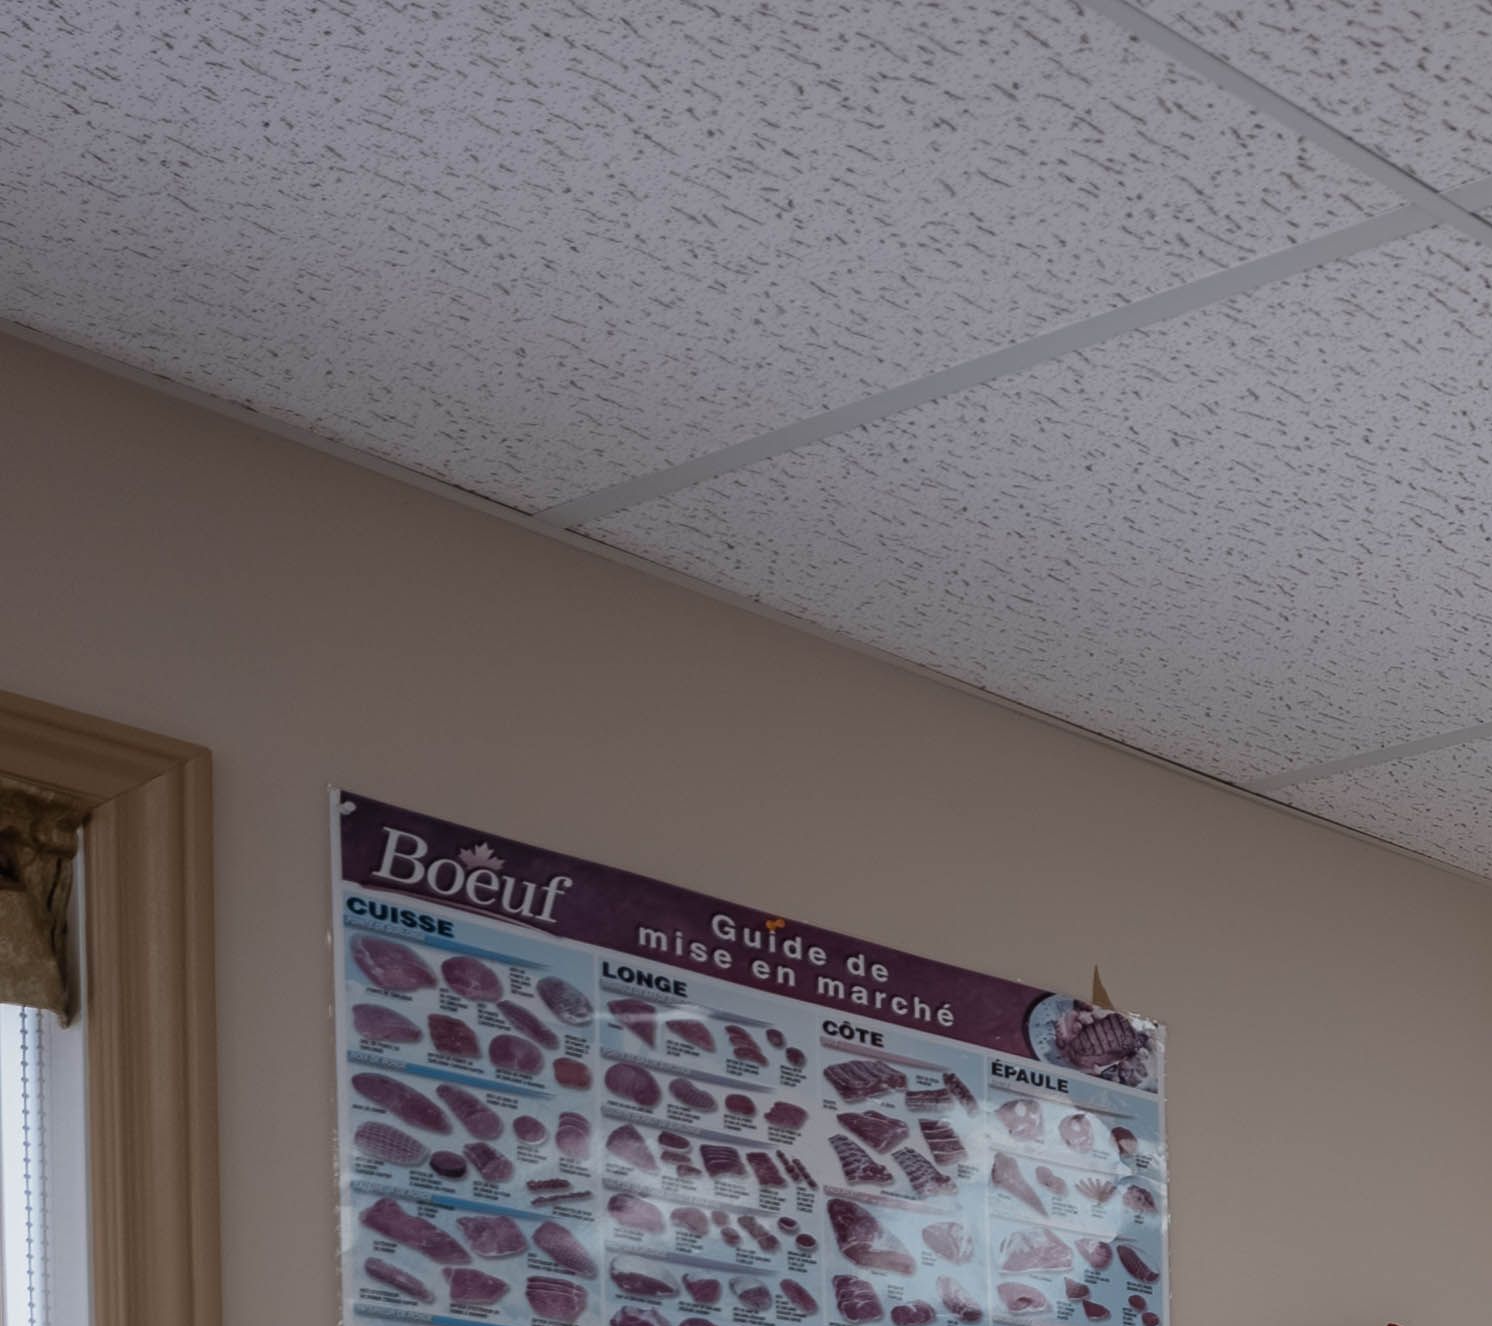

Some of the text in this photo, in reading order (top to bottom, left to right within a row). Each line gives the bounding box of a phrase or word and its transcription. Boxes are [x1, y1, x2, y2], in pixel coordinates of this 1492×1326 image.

[347, 897, 455, 938] CUISSE
[711, 913, 889, 984] Guide de
[602, 961, 688, 997] LONGE
[638, 924, 956, 1028] mise en marché
[822, 1019, 884, 1048] CÔTE
[990, 1058, 1069, 1094] ÉPAULE
